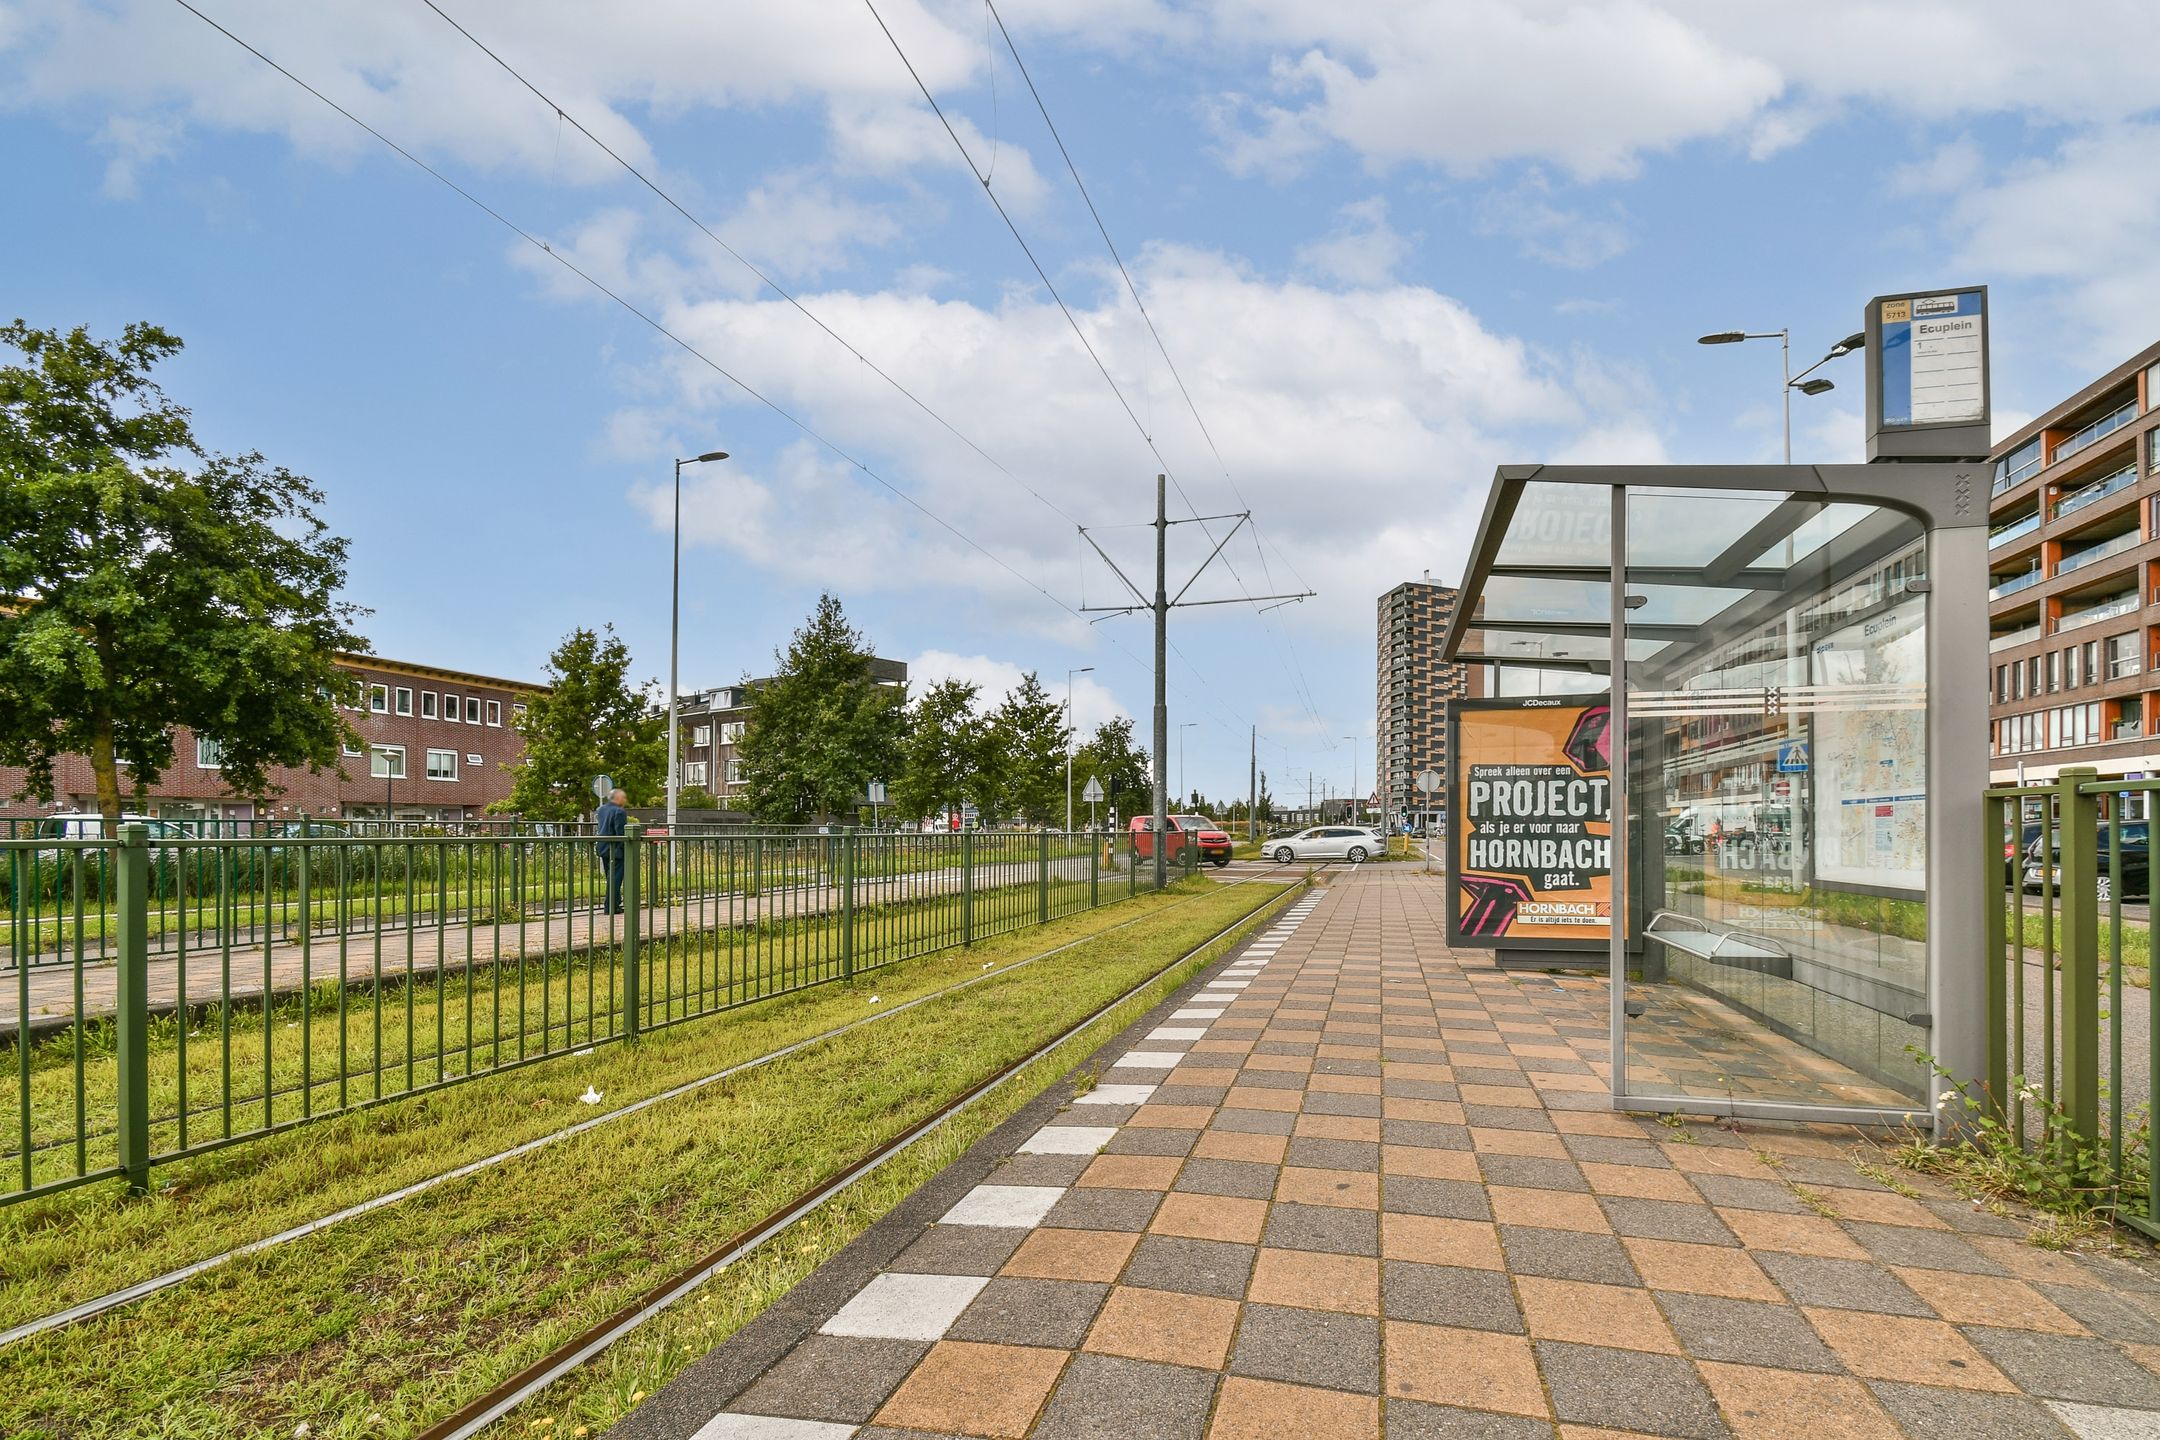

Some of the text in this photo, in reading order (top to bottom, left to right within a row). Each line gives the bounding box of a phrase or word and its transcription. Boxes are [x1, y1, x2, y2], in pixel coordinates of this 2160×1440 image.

[1886, 311, 1906, 319] 5713
[1919, 320, 1972, 335] Ecuplein
[1864, 615, 1897, 637] Ecuplein
[1522, 699, 1561, 707] JCDecaux
[1474, 766, 1571, 779] Spreek alleen over een
[1470, 779, 1611, 821] PROJECT,
[1480, 821, 1580, 837] als je er voor naar
[1470, 838, 1611, 869] HORNBACH
[1543, 872, 1580, 890] gaat.
[1519, 903, 1594, 915] HORNBACH
[1545, 916, 1560, 924] altijd
